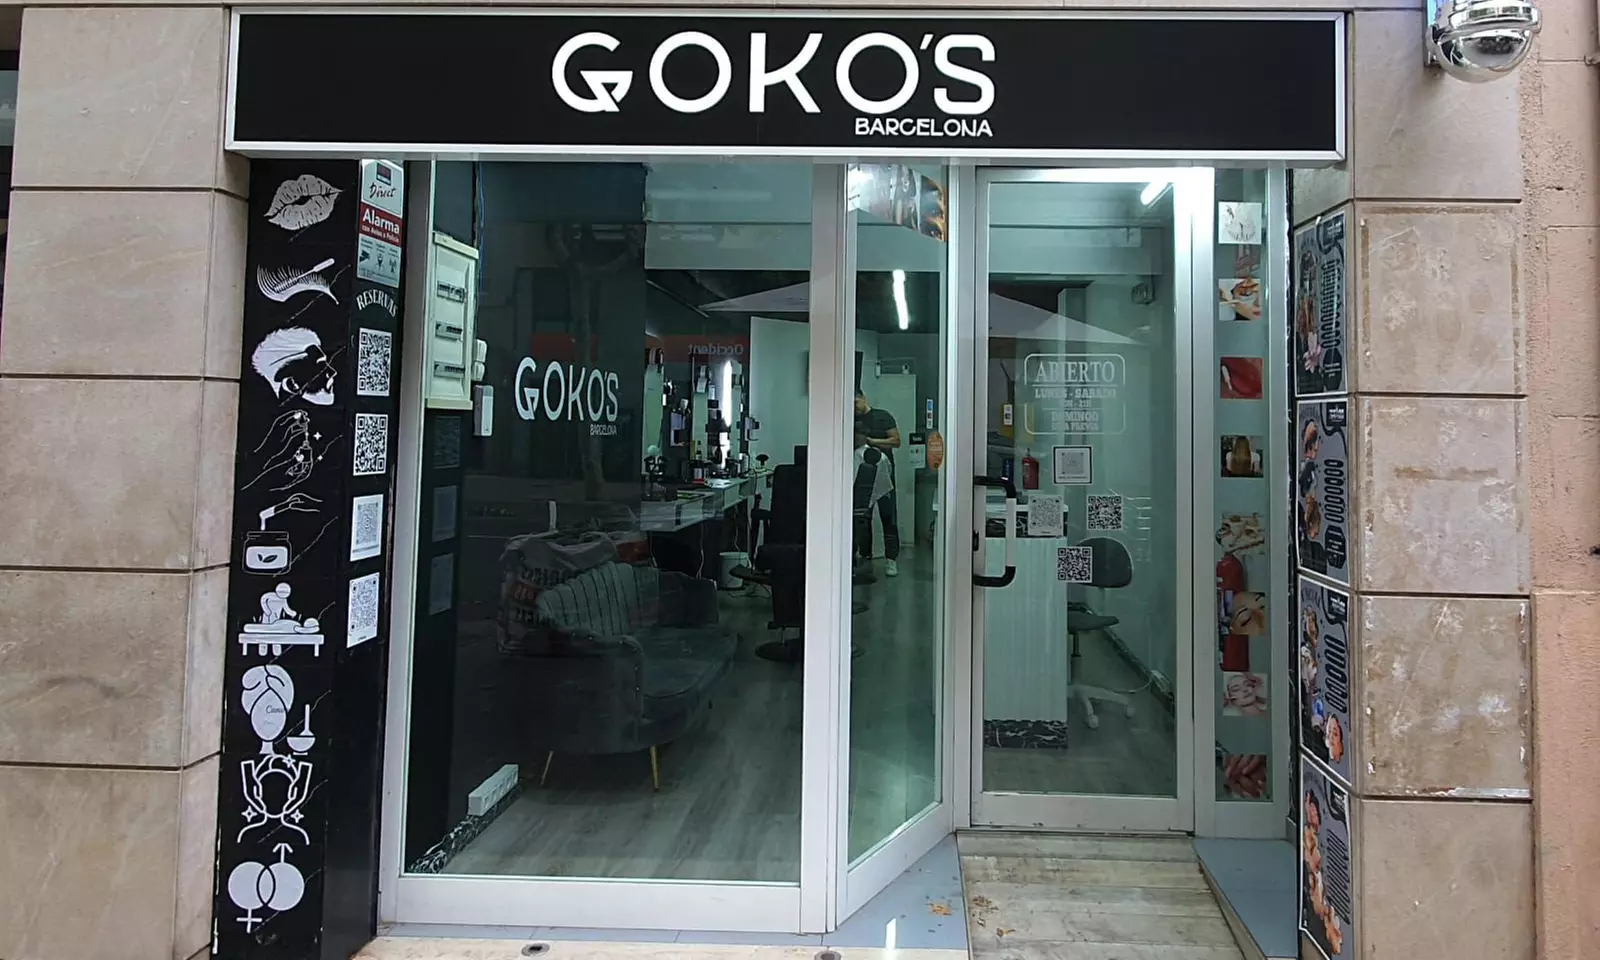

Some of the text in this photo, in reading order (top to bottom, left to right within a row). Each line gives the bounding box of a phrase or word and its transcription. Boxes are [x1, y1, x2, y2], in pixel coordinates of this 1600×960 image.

[552, 31, 995, 115] GOKO'S
[855, 117, 993, 137] BARCELONA
[369, 182, 396, 199] Direct
[362, 208, 400, 234] Alarma
[356, 289, 398, 318] RESERVAS
[1034, 361, 1116, 382] ABIERTO
[515, 356, 619, 421] GOKO'S
[1052, 411, 1099, 421] DMINGO
[589, 424, 618, 435] BARCELONA
